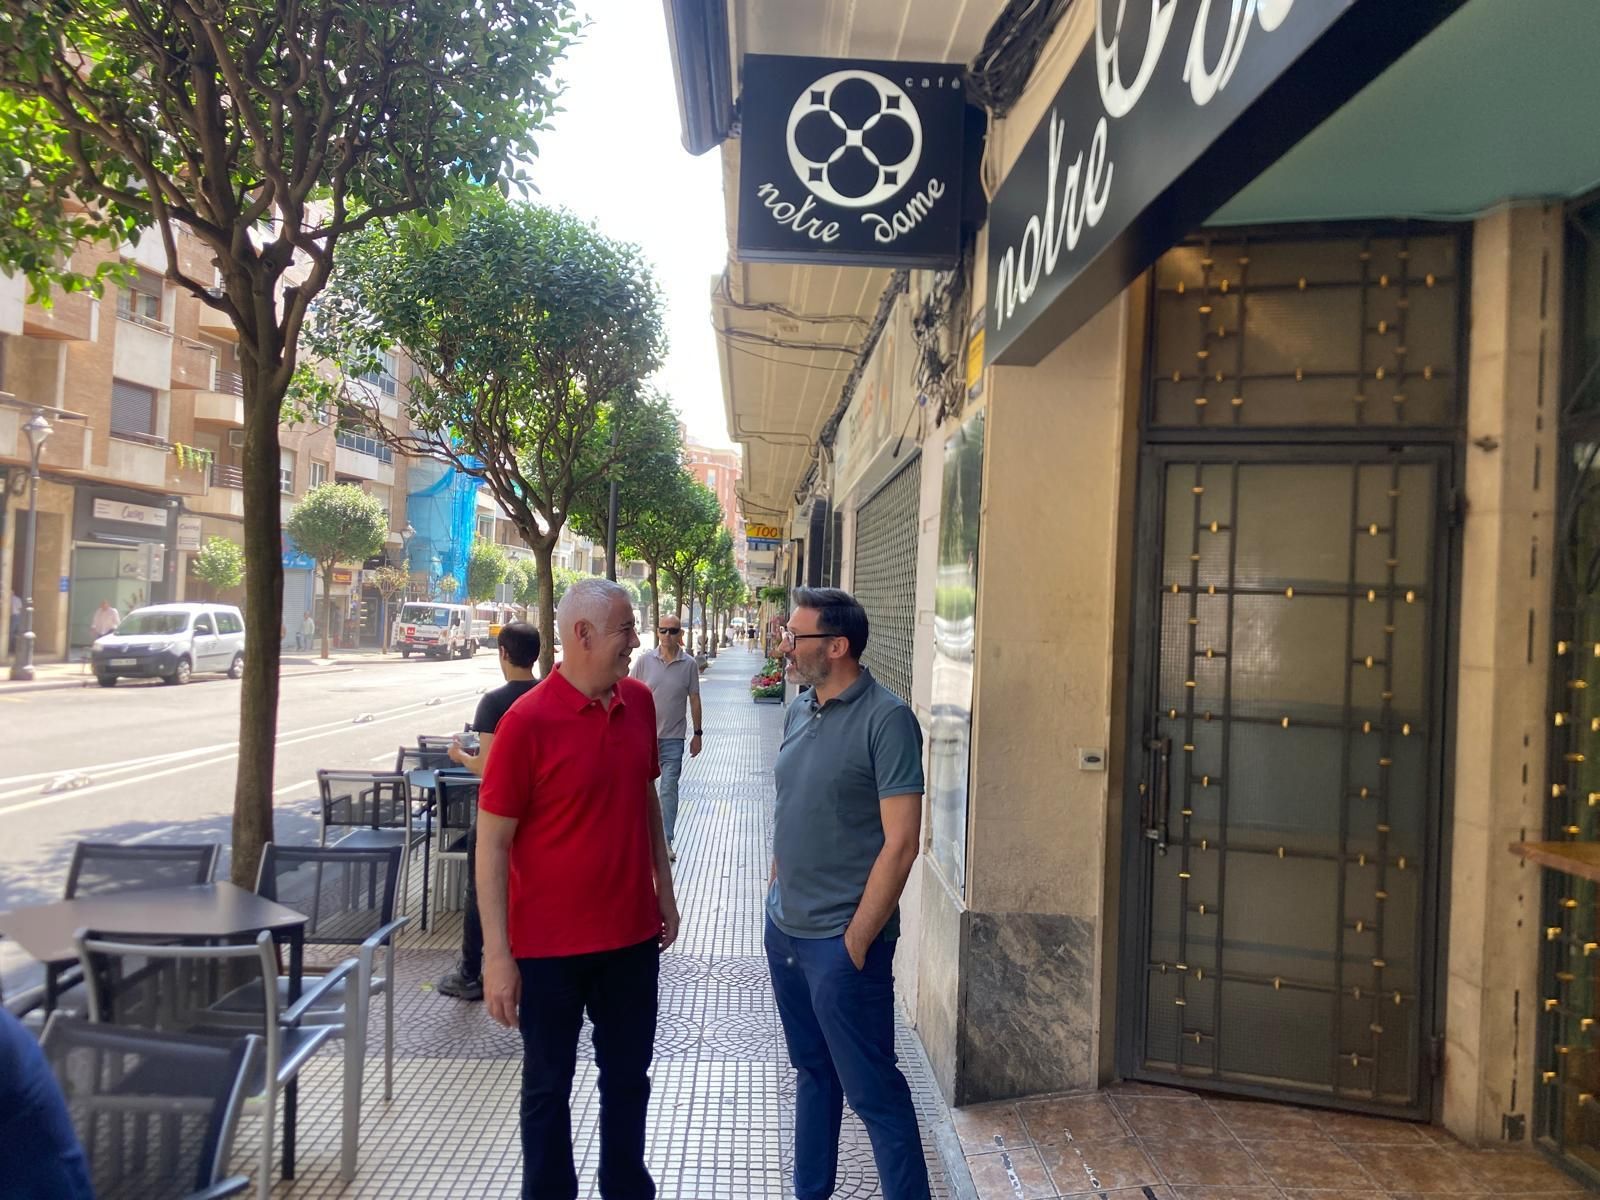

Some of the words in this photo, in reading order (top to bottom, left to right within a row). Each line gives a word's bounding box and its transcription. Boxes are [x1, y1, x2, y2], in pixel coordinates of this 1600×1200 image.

[904, 75, 961, 89] café
[756, 180, 841, 243] notre
[861, 177, 946, 243] dame
[995, 106, 1114, 331] notre
